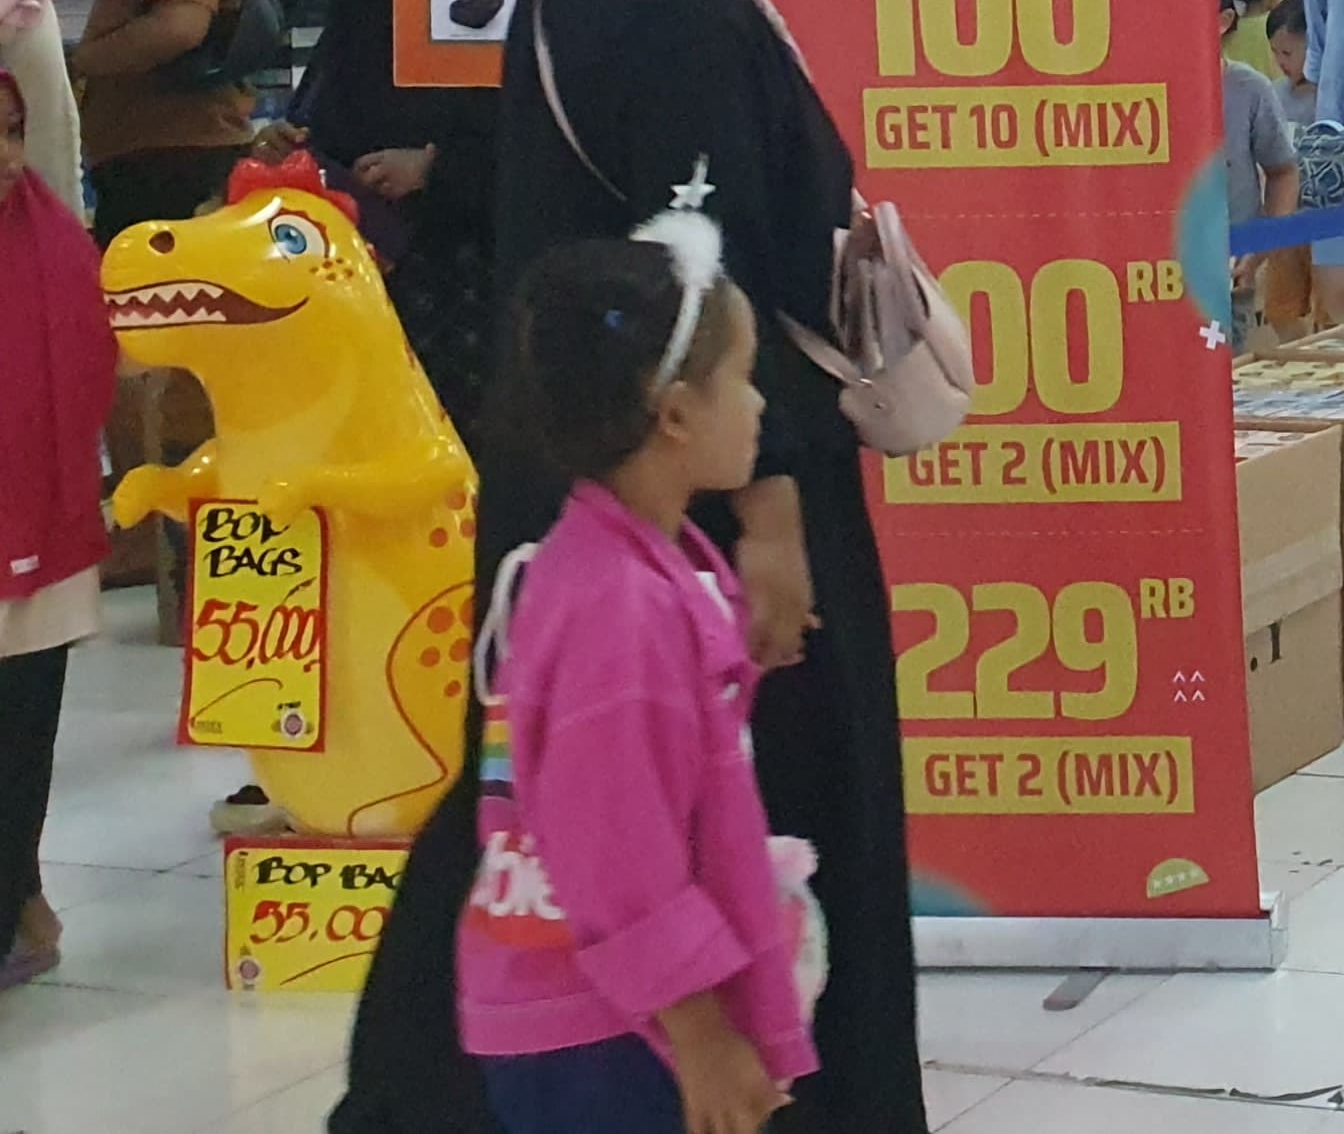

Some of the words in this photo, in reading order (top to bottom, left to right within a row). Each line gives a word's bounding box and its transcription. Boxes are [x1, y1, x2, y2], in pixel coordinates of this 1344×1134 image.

[875, 104, 961, 152] GET
[968, 101, 1018, 150] 10
[1034, 97, 1163, 158] (MIX)
[1127, 261, 1184, 303] RB
[906, 443, 993, 487] GET
[1001, 441, 1028, 484] 2
[1042, 435, 1168, 495] (MIX)
[203, 545, 303, 579] BAGS
[890, 581, 1138, 721] 229
[1140, 578, 1196, 620] RB
[924, 755, 1009, 798] GET
[1017, 754, 1044, 796] 2
[1056, 749, 1181, 807] (MIX)
[255, 856, 332, 888] BOP
